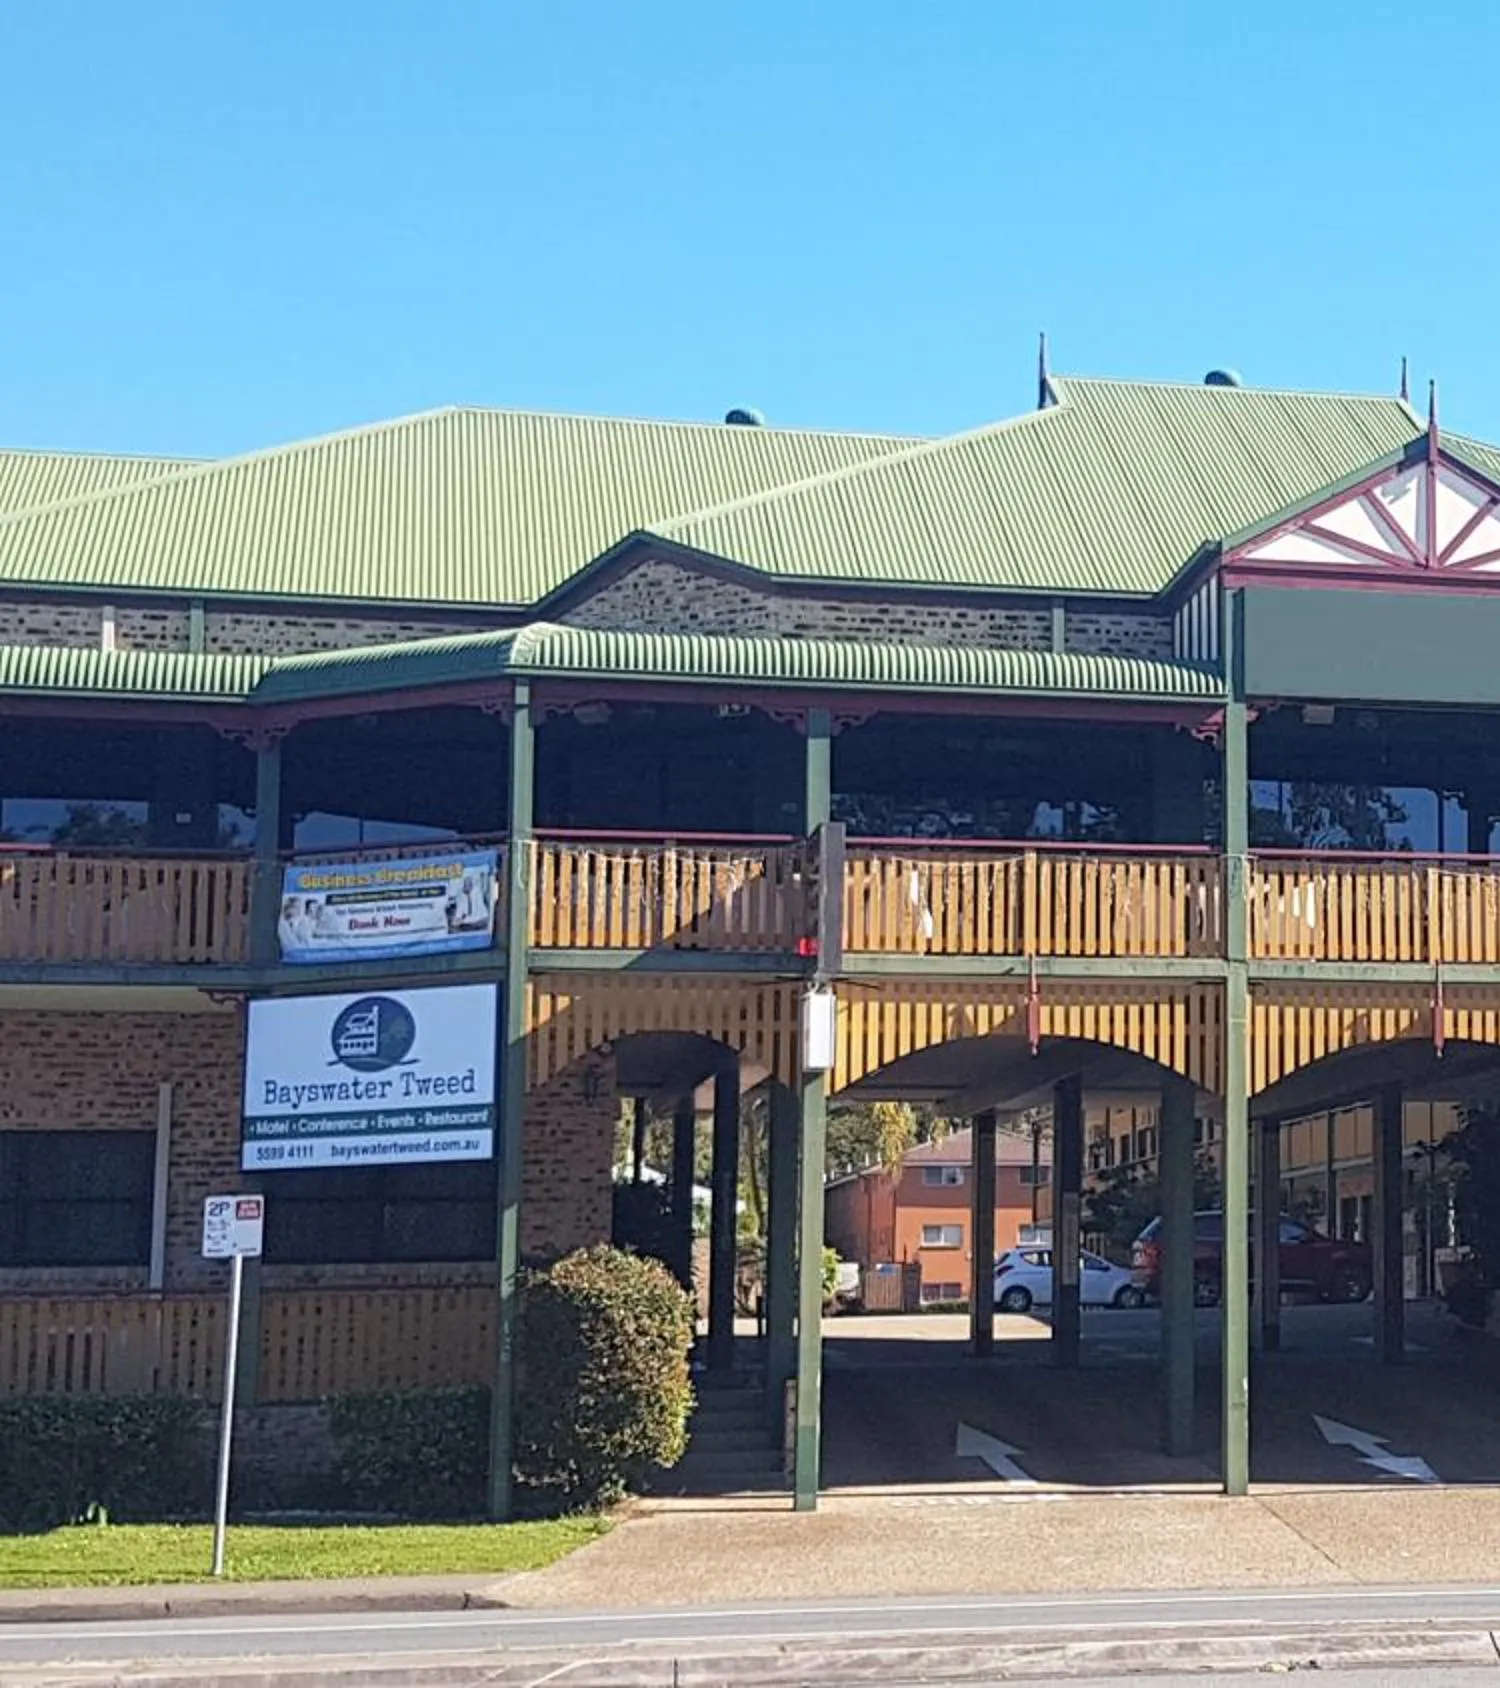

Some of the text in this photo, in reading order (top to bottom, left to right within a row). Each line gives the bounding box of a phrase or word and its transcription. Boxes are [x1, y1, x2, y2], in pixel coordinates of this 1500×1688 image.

[264, 1069, 475, 1109] Bayswater Tweed
[256, 1108, 488, 1135] Motel Conference Events Restaurant
[256, 1138, 480, 1161] 5599 4111 bayswatertweed.com.au
[208, 1201, 231, 1217] 2P
